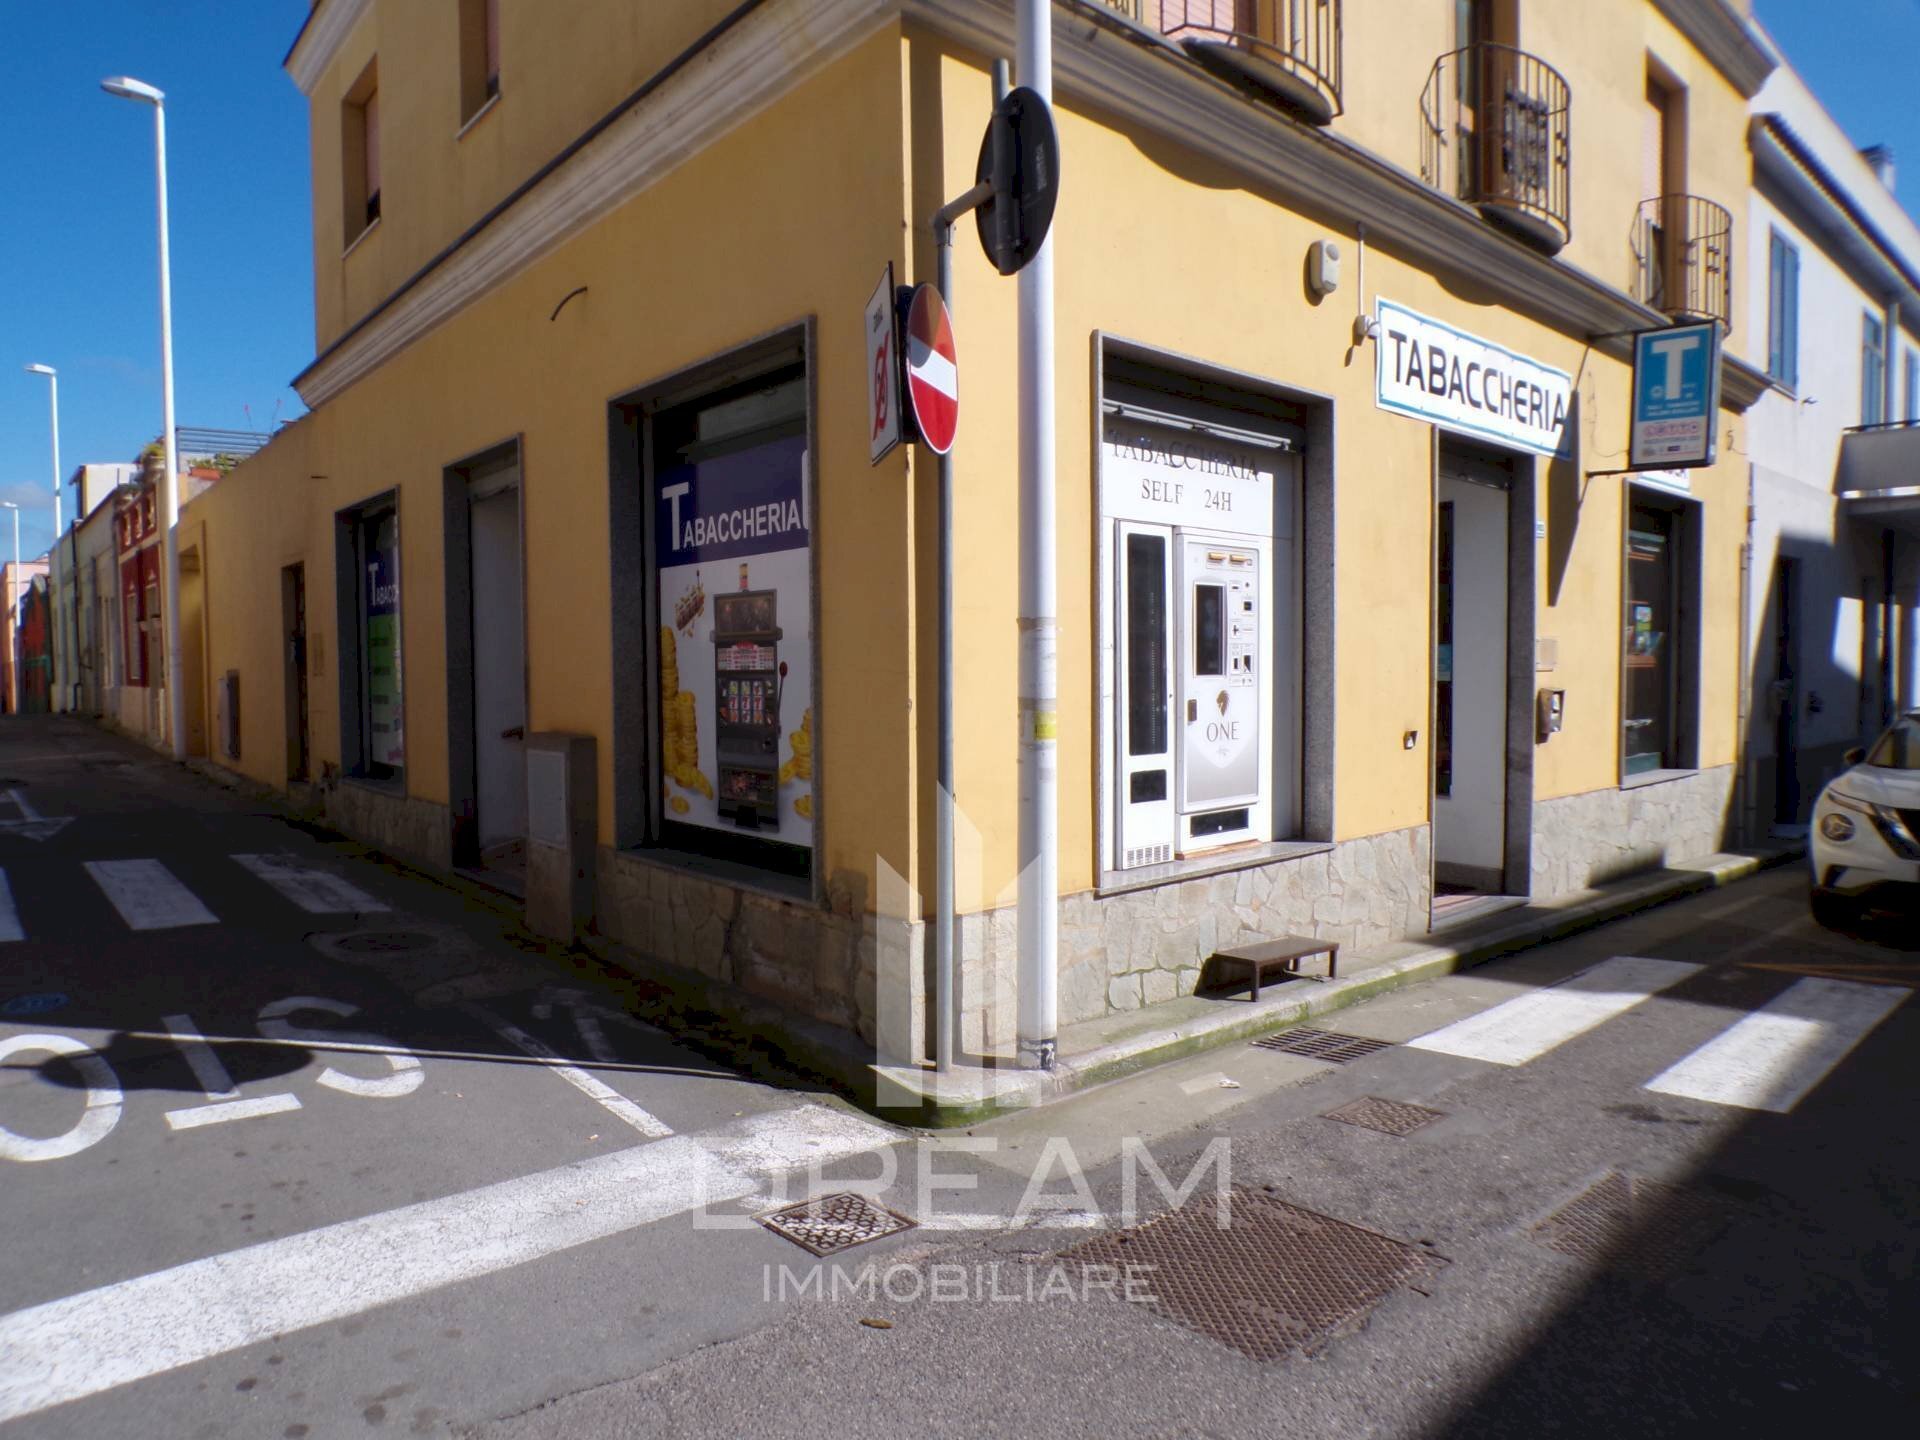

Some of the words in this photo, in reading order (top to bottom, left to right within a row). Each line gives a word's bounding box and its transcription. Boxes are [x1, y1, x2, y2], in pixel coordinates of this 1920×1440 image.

[1388, 329, 1568, 433] TABACCHERIA
[1651, 336, 1700, 400] T
[1108, 429, 1260, 482] TABACCHERIA
[661, 481, 801, 551] TABACCHERIA
[1141, 478, 1184, 504] SELF
[1204, 488, 1233, 512] 24H
[1206, 721, 1240, 742] ONE
